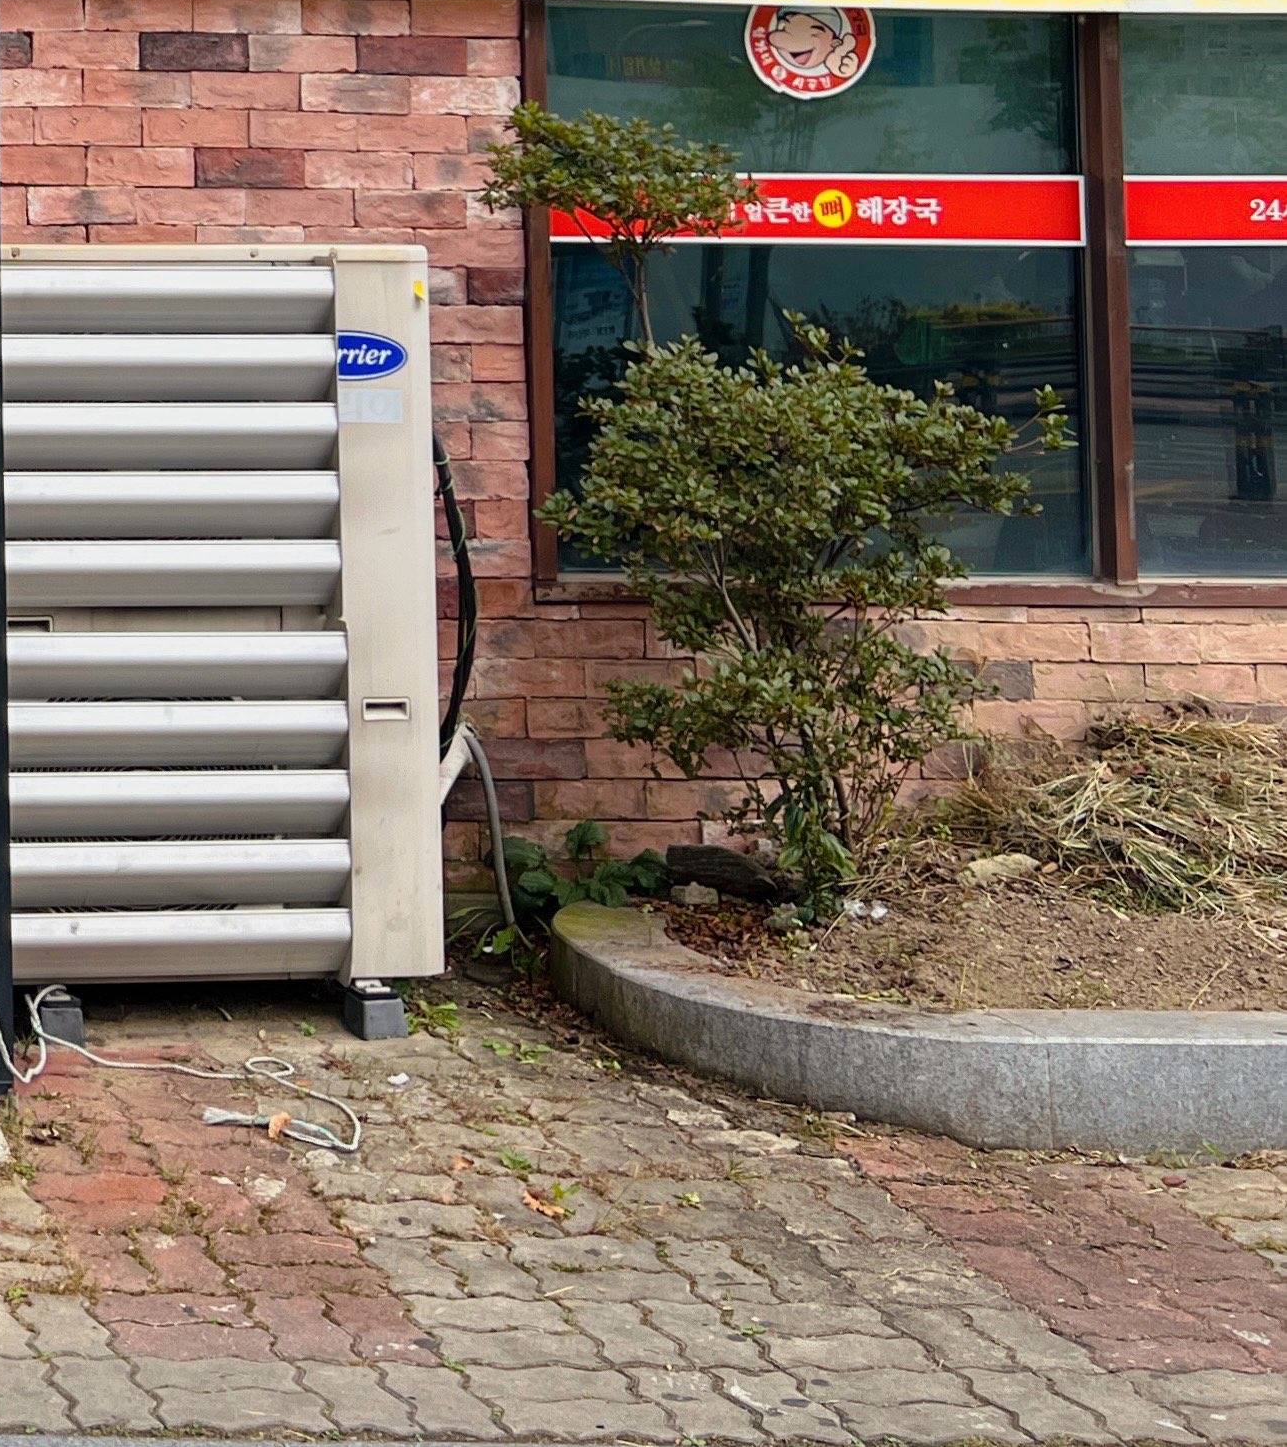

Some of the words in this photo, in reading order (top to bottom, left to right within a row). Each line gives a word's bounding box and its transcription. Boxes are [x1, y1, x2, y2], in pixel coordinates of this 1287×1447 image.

[855, 197, 943, 226] 해장국
[1249, 198, 1287, 221] 24
[337, 345, 392, 366] rrier
